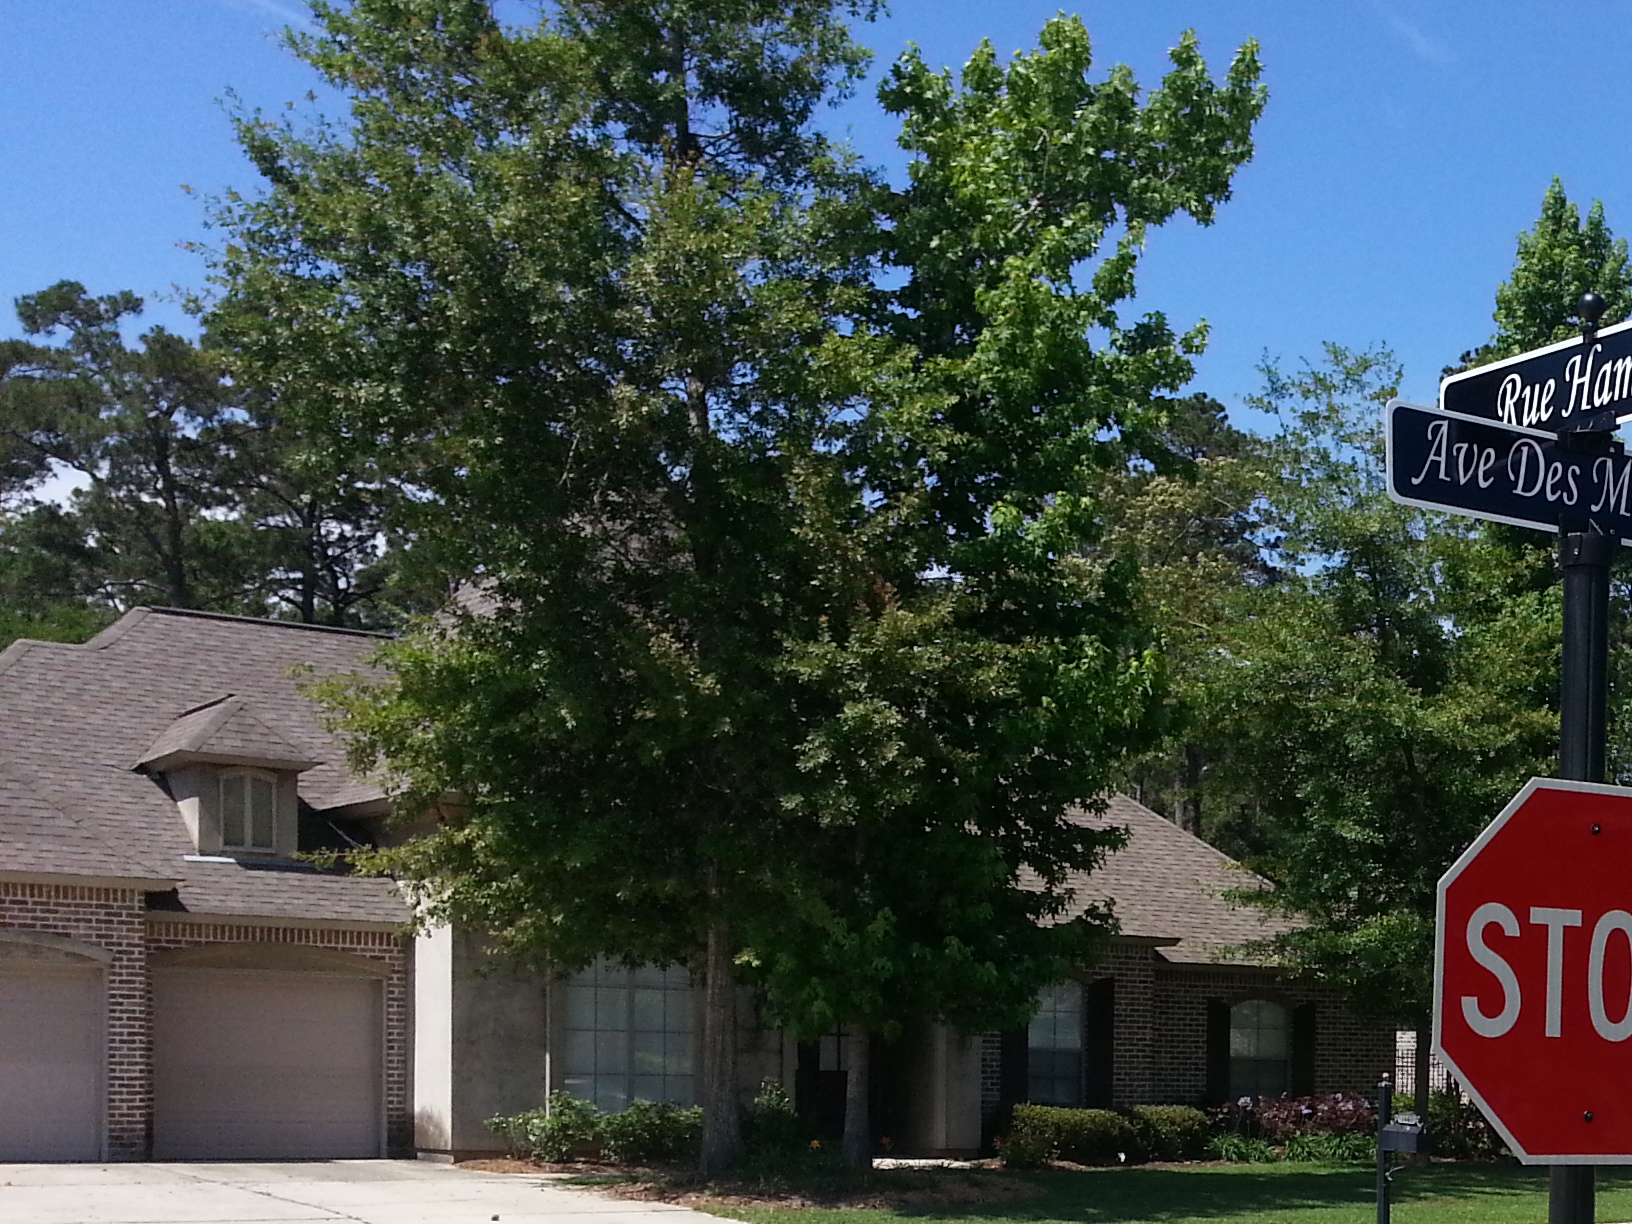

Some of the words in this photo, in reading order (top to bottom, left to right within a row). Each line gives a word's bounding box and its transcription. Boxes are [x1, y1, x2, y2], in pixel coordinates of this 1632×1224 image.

[1497, 373, 1556, 428] Rue
[1411, 420, 1496, 489] Ave
[1507, 437, 1581, 506] Des
